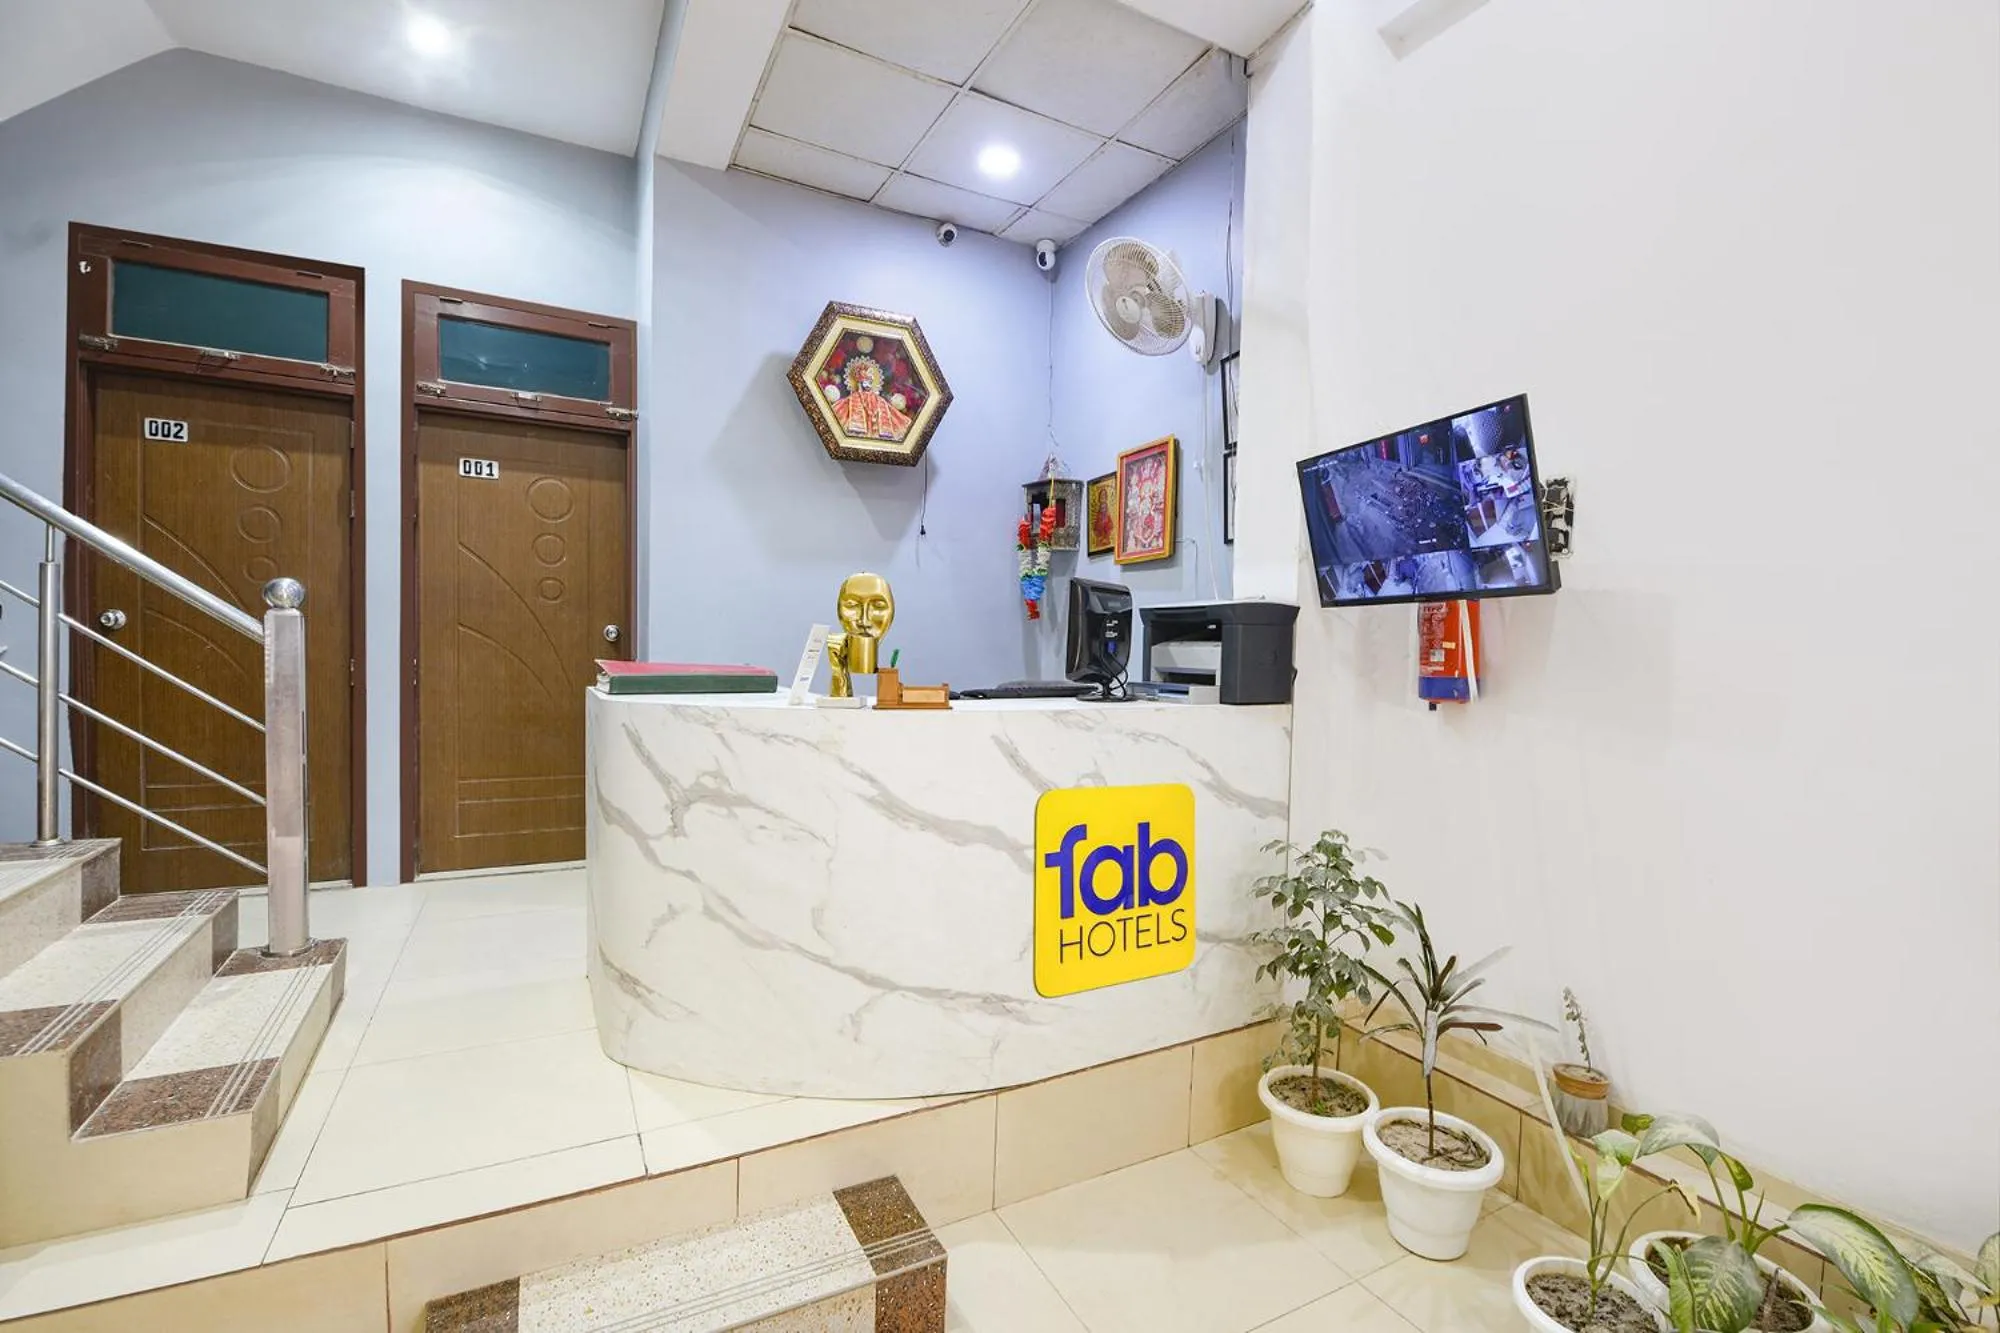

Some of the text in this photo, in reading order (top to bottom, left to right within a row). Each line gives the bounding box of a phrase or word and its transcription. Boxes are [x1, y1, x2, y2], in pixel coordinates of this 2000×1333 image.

[149, 420, 184, 439] 002
[463, 460, 495, 477] 001
[1045, 822, 1188, 919] fab
[1060, 908, 1187, 964] HOTELS
